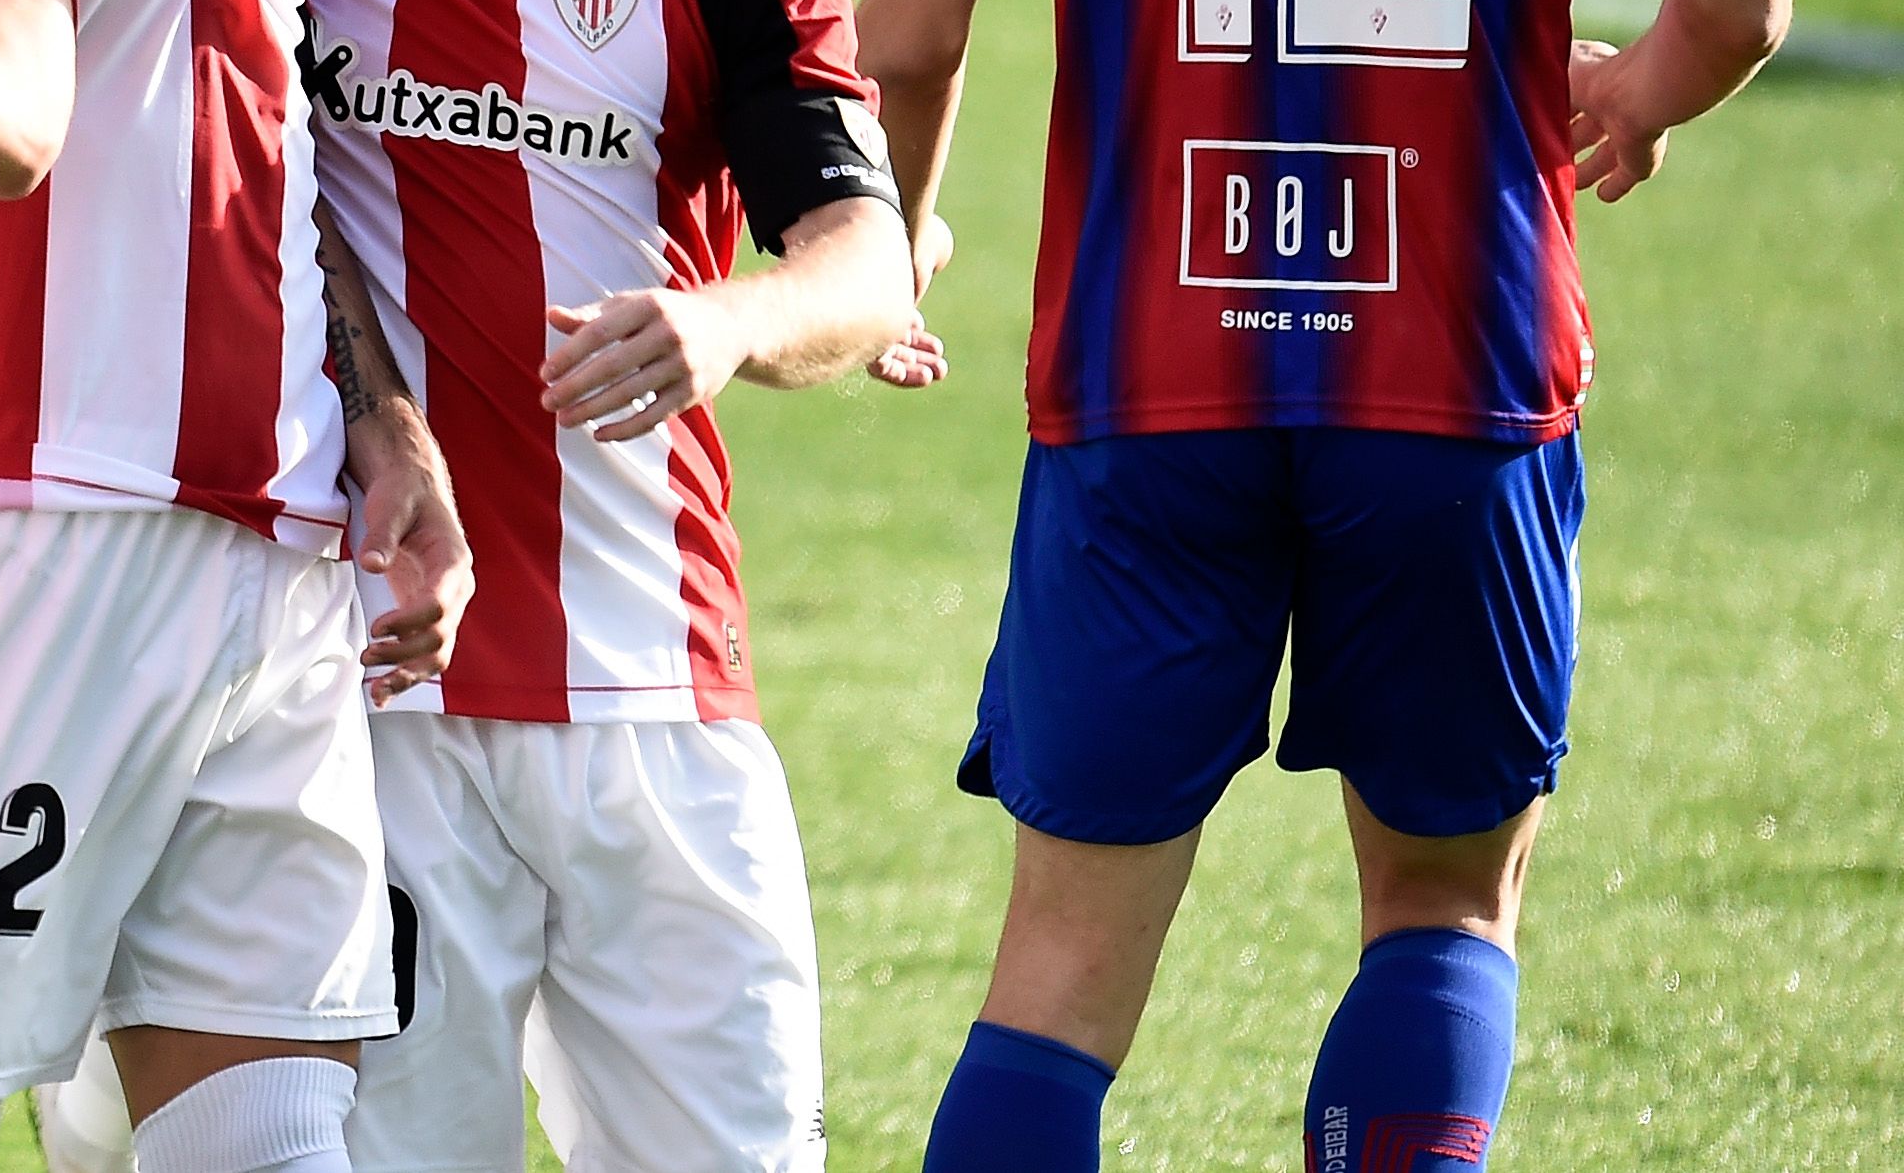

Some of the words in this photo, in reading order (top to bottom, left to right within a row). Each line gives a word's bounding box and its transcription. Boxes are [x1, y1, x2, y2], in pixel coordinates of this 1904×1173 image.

[576, 18, 615, 43] BILBAO
[294, 8, 632, 160] Kutxabank
[1220, 310, 1293, 330] SINCE
[1301, 313, 1354, 332] 1905
